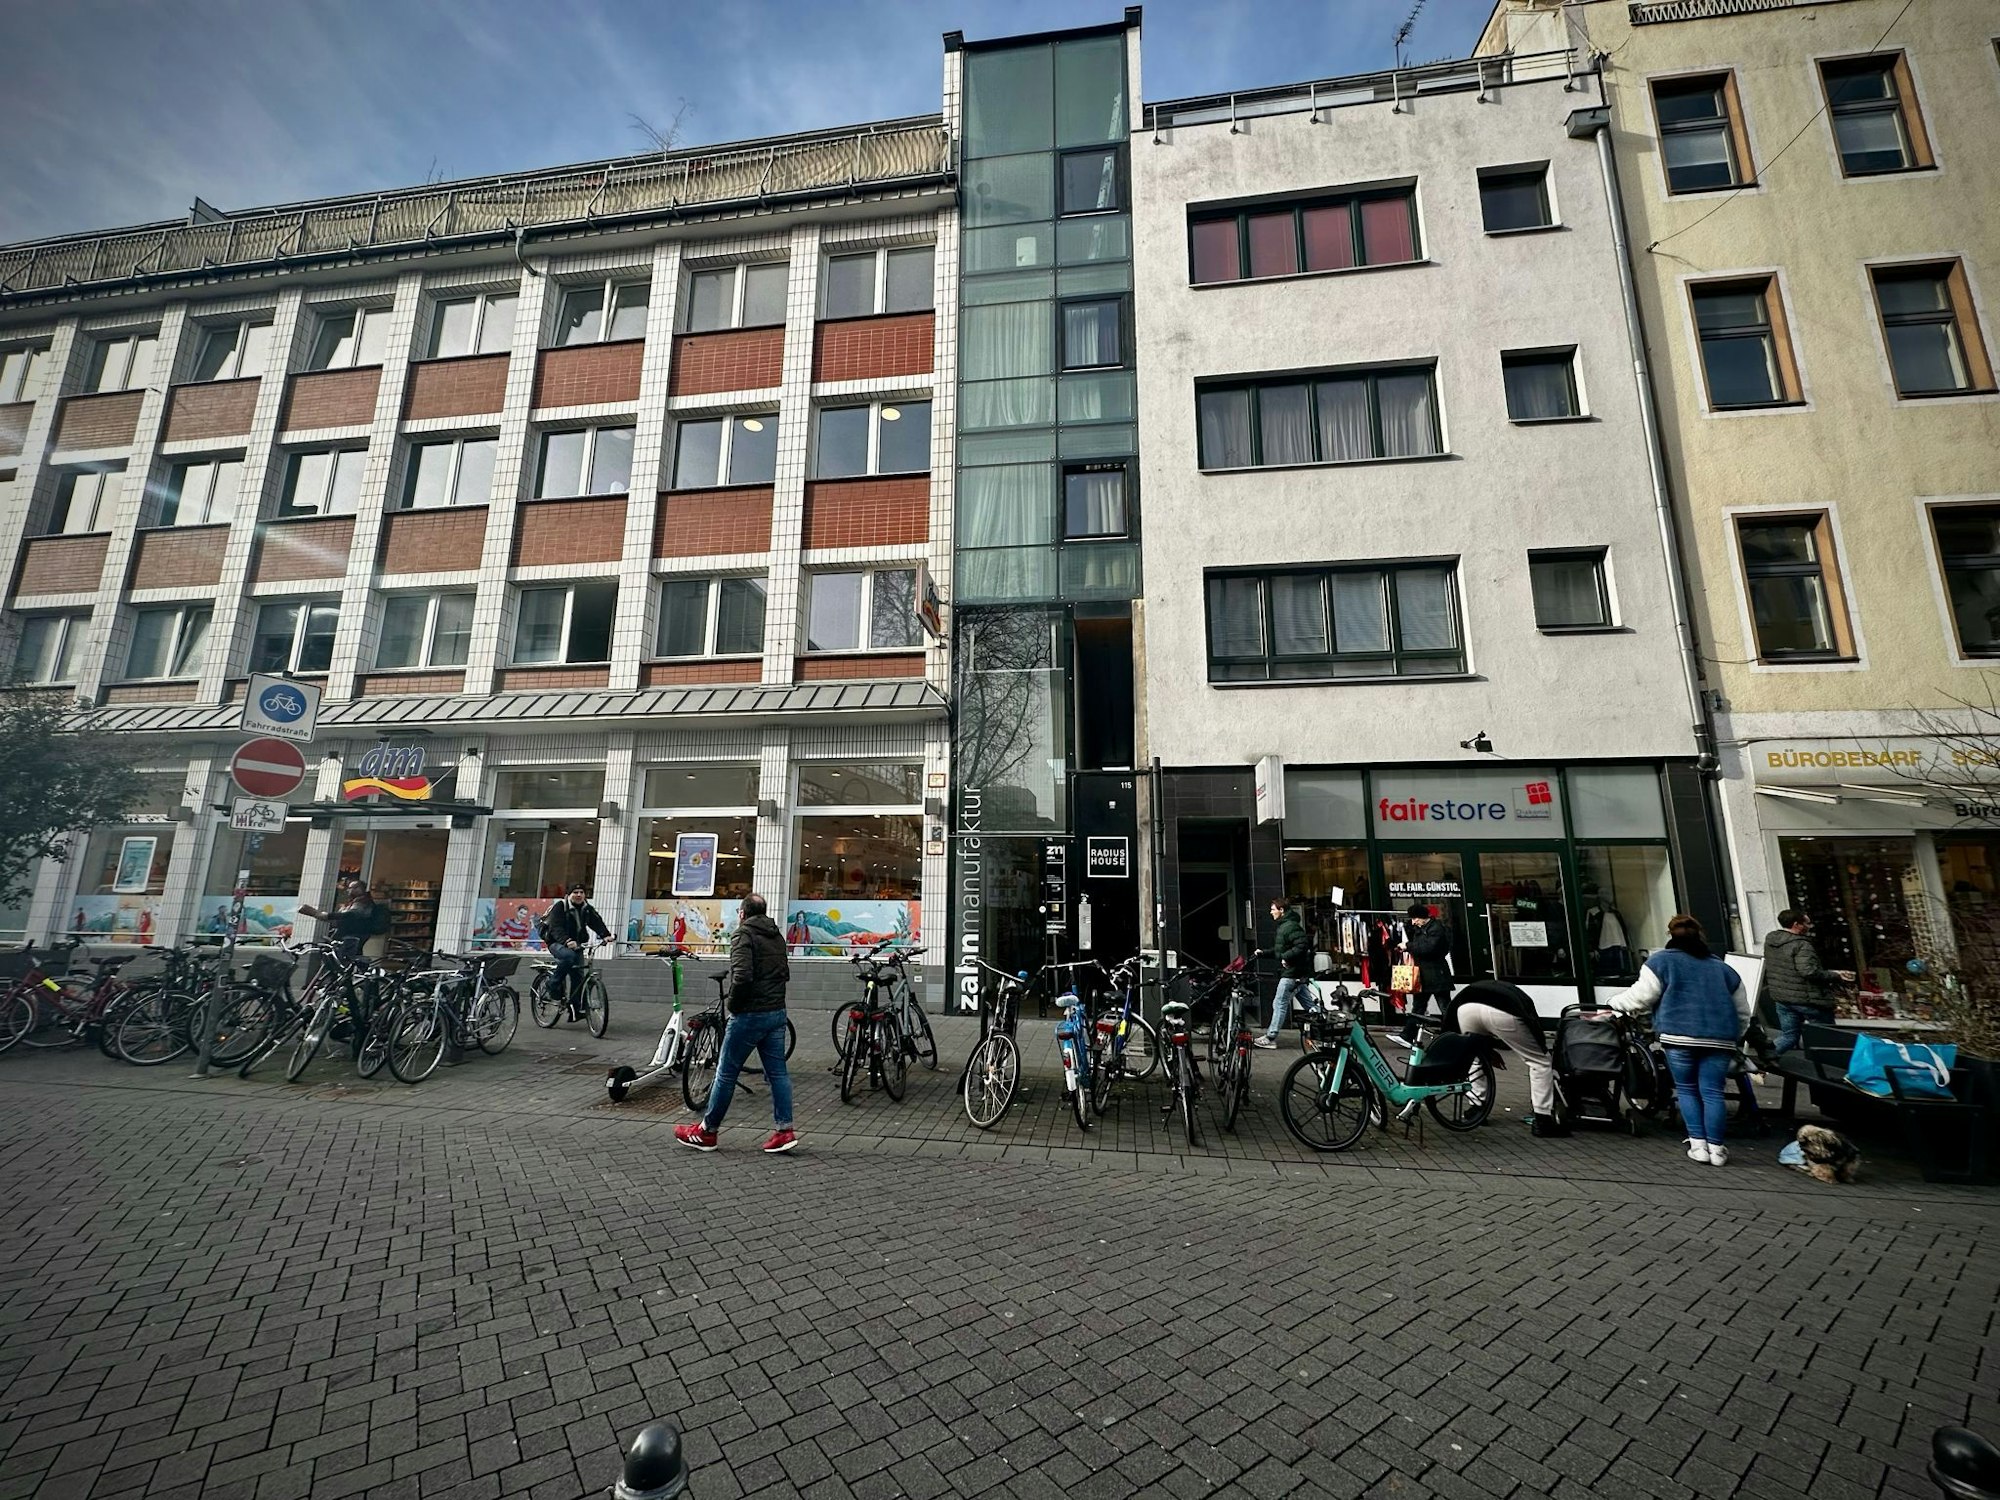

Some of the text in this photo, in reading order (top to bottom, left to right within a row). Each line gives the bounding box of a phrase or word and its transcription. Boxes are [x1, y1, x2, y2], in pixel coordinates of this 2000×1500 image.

[246, 720, 309, 738] Fahrradstraße
[359, 741, 425, 777] dm
[1767, 749, 1922, 768] BÜROBEDARF
[1379, 798, 1506, 821] fairstore
[1090, 848, 1125, 857] RADIUS
[1090, 857, 1125, 866] HOUSE
[1389, 881, 1461, 892] GUT. FAIR. GÜNSTIG.
[955, 783, 982, 1011] zahnmanufaktur
[1516, 900, 1537, 909] OPEN
[1369, 1048, 1394, 1089] TIER
